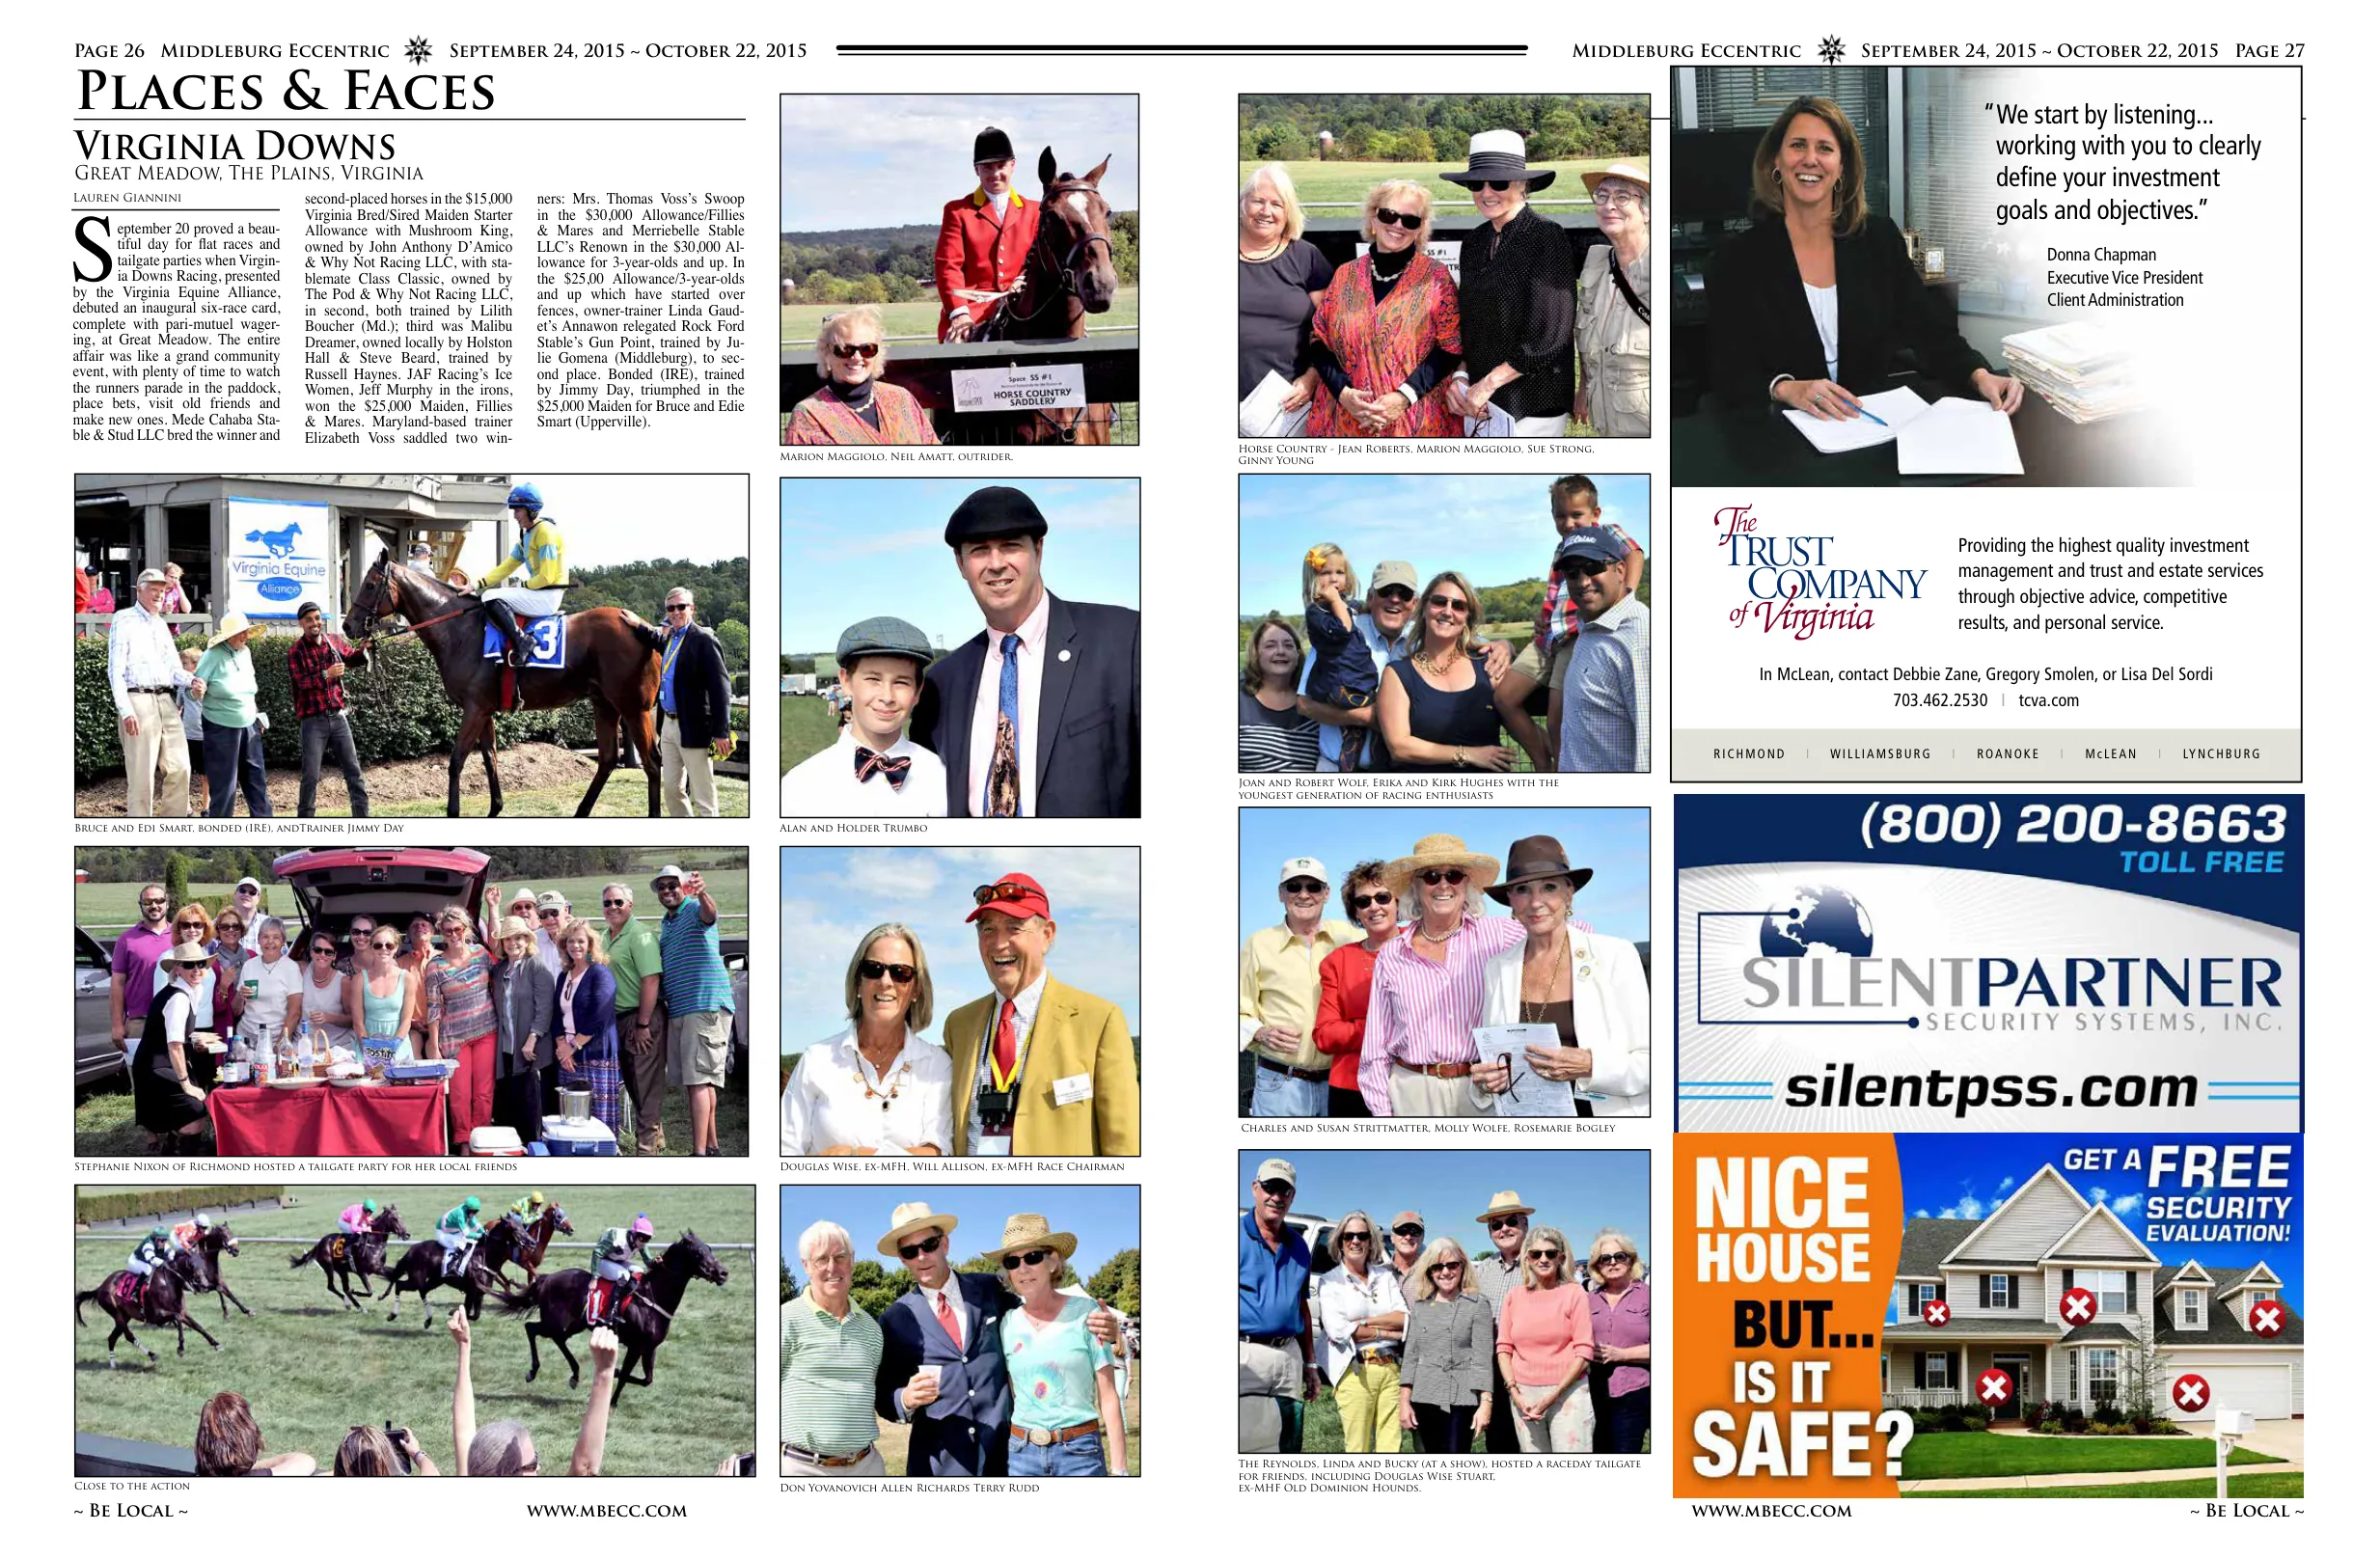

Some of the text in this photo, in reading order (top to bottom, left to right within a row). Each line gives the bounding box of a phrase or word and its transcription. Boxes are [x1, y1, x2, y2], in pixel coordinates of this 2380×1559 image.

[2035, 106, 2079, 123] start
[2086, 103, 2107, 129] by
[2115, 103, 2212, 129] listening...
[1996, 134, 2261, 160] working with you to clearly
[1997, 165, 2220, 192] define your investment
[1997, 199, 2047, 225] goals
[2055, 199, 2091, 219] and
[304, 240, 344, 253] owned
[349, 241, 363, 256] by
[369, 240, 397, 253] John
[402, 241, 451, 256] Anthony
[2047, 247, 2156, 264] Donna Chapman
[117, 254, 281, 269] tailgate parties when Virgin-
[2047, 269, 2204, 285] Executive Vice President
[2047, 291, 2184, 307] Client Administration
[536, 304, 745, 318] fences, owner-trainer Linda Gaud-
[994, 388, 1072, 399] HORSE COUNTRY
[1010, 397, 1056, 406] SADDLERY
[536, 398, 745, 414] $25,000 Maiden for Bruce and Edie
[536, 415, 650, 430] Smart (Upperville).
[1713, 504, 1758, 546] The
[1720, 533, 1834, 567] TRUST
[1959, 537, 2249, 557] Providing the highest quality investment
[233, 561, 325, 577] Virginia Equine
[260, 584, 300, 594] Alliance
[1747, 565, 1929, 601] COMPANY
[1729, 585, 1875, 641] of Virginia
[533, 620, 558, 660] 3
[1760, 666, 2213, 684] In McLean, contact Debbie Zane, Gregory Smolen, or Lisa Del Sordi
[1893, 693, 1988, 707] 703.462.2530
[2018, 694, 2080, 707] tcva.com
[1713, 748, 1785, 759] RICHMOND
[1829, 748, 1930, 759] WILLIAMSBURG
[1977, 748, 2038, 759] ROANOKE
[2085, 748, 2136, 759] McLEAN
[2183, 748, 2260, 759] LYNCHBURG
[1862, 802, 2286, 848] (800) 200-8663
[2121, 852, 2284, 872] TOLL FREE
[1928, 1013, 2281, 1033] SECURITY SYSTEMS, INC.
[1786, 1064, 2197, 1117] silentpss.com
[2064, 1149, 2142, 1171] GET A
[2147, 1145, 2291, 1190] FREE
[1696, 1157, 1870, 1229] NICE
[2147, 1197, 2291, 1219] SECURITY
[2146, 1226, 2290, 1243] EVALUATION!
[1697, 1235, 1871, 1283] HOUSE
[591, 1290, 602, 1320] 1
[1736, 1300, 1873, 1348] BUT...
[1736, 1361, 1830, 1403] IS IT
[1692, 1409, 1915, 1479] SAFE?
